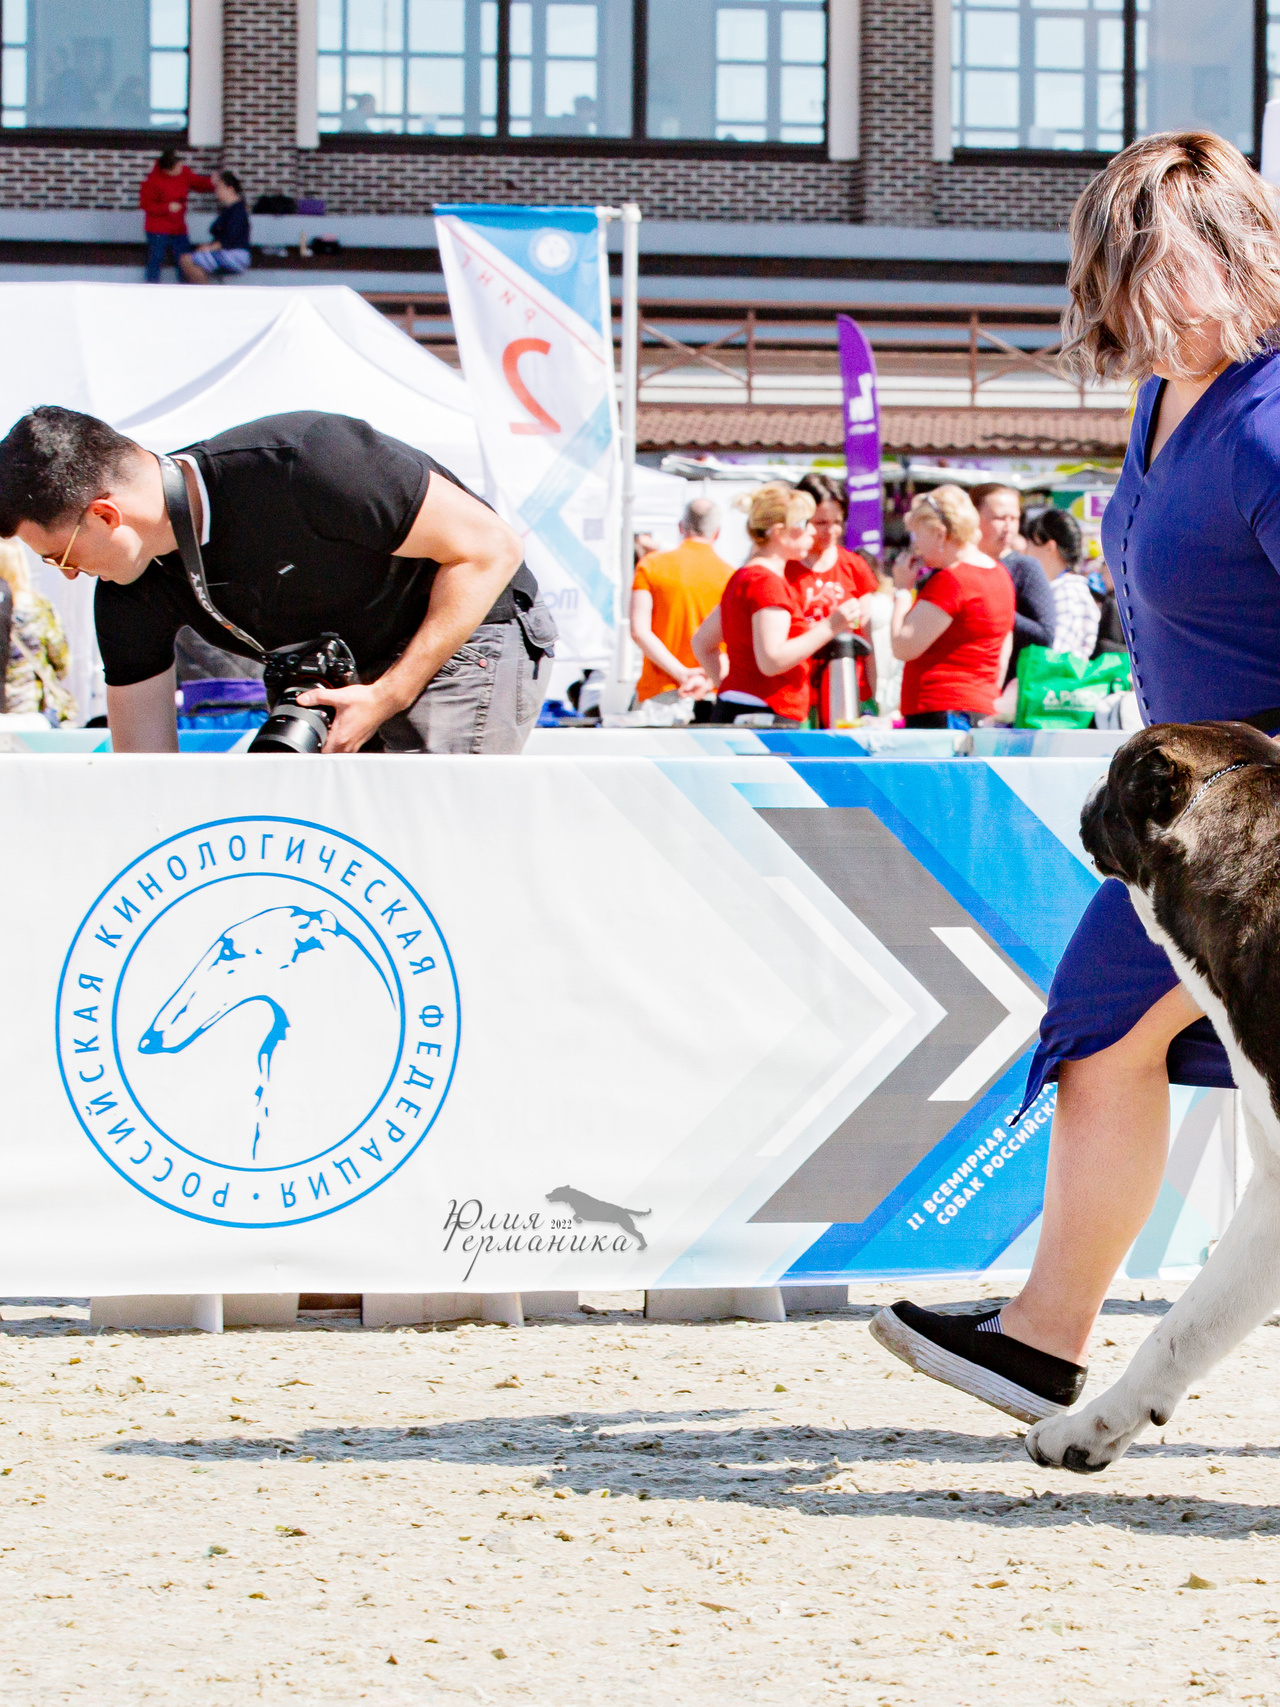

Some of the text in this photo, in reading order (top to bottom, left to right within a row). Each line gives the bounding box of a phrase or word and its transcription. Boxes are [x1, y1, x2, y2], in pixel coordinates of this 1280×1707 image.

[73, 834, 445, 1209] РОССИЙСКАЯ КИНОЛОГИЧЕСКАЯ ФЕДЕРАЦИЯ
[923, 1126, 1007, 1215] ВСЕМИРНАЯ
[936, 1176, 985, 1226] СОБАК
